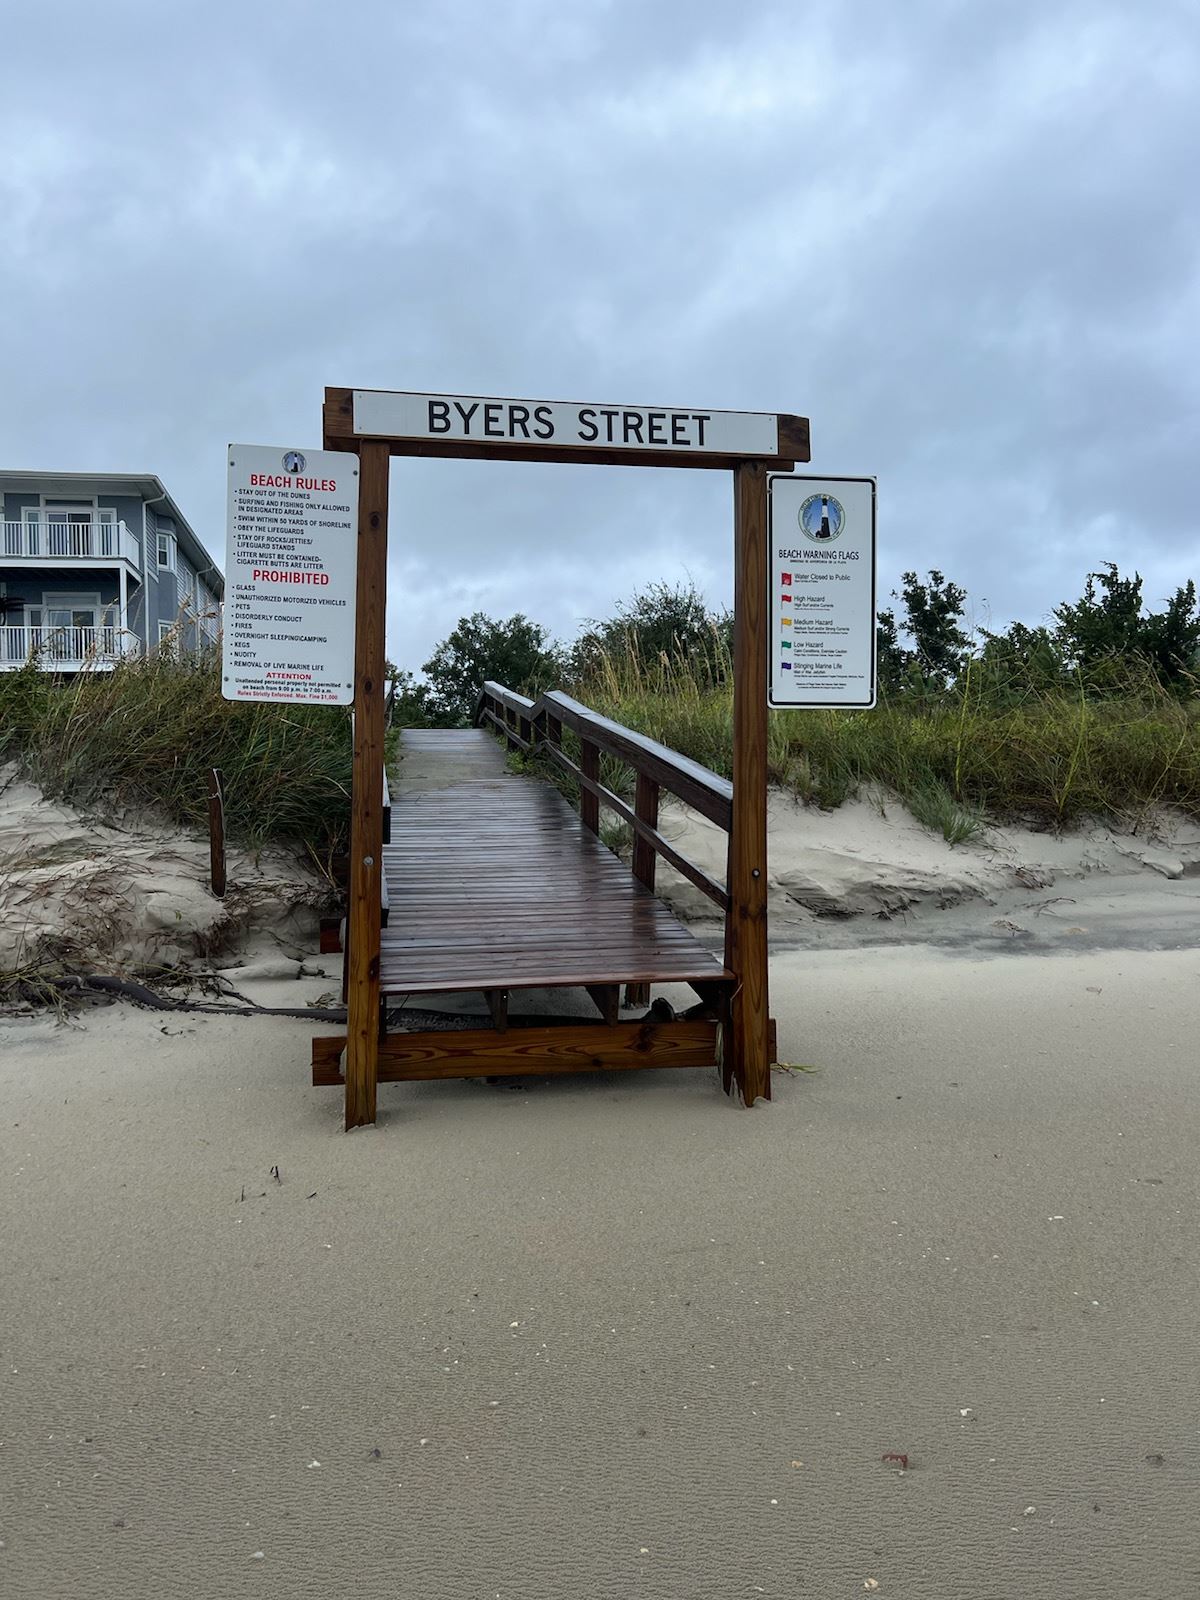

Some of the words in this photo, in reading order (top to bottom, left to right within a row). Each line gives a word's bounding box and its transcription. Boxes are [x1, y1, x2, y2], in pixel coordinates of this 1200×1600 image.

[428, 401, 554, 439] BYERS
[578, 410, 710, 446] STREET
[251, 474, 291, 488] BEACH
[296, 478, 336, 491] RULES
[322, 504, 350, 512] ALLOWED
[779, 550, 801, 558] BEACH
[803, 550, 837, 559] WARNING
[839, 551, 859, 560] FLAGS
[254, 570, 329, 585] PROHIBITED
[266, 672, 311, 680] ATTENTION
